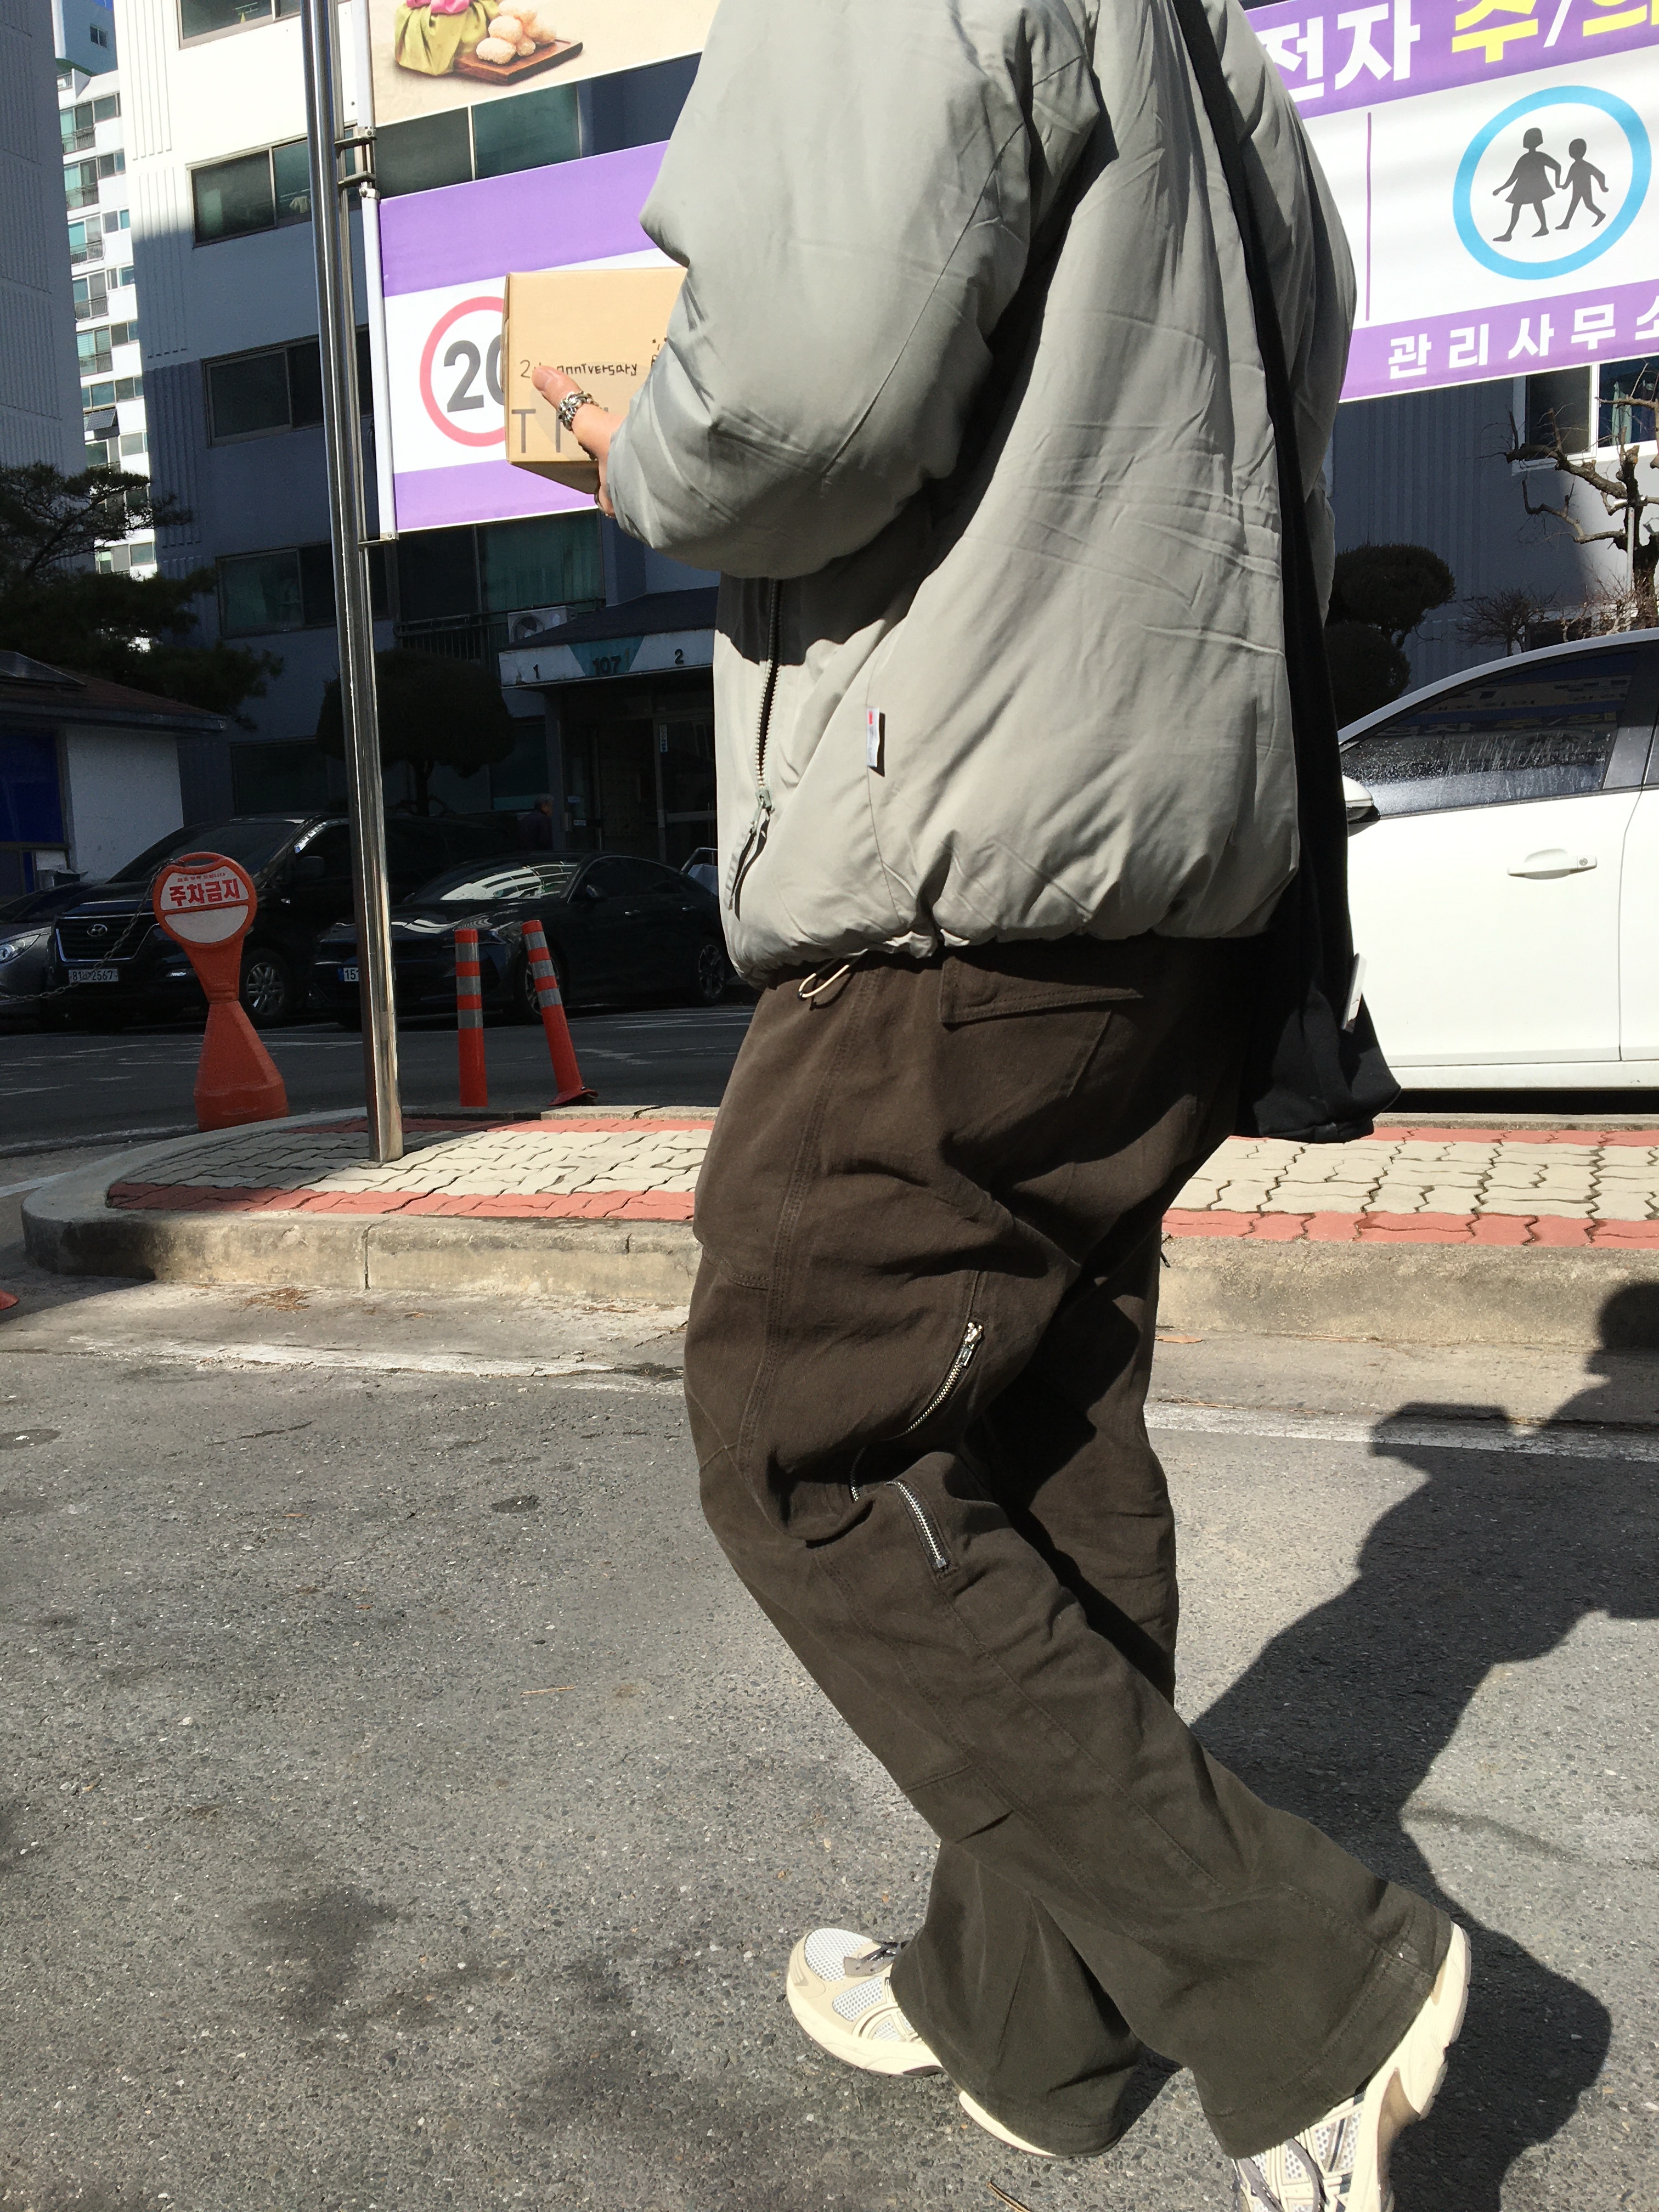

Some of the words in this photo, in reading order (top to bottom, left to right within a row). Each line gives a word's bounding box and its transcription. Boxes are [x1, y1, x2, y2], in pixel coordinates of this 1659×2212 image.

[1257, 0, 1421, 102] 전자
[533, 664, 540, 679] 1
[592, 655, 622, 676] 107
[675, 648, 684, 665] 2
[169, 878, 240, 906] 주차금지
[345, 969, 359, 980] 15
